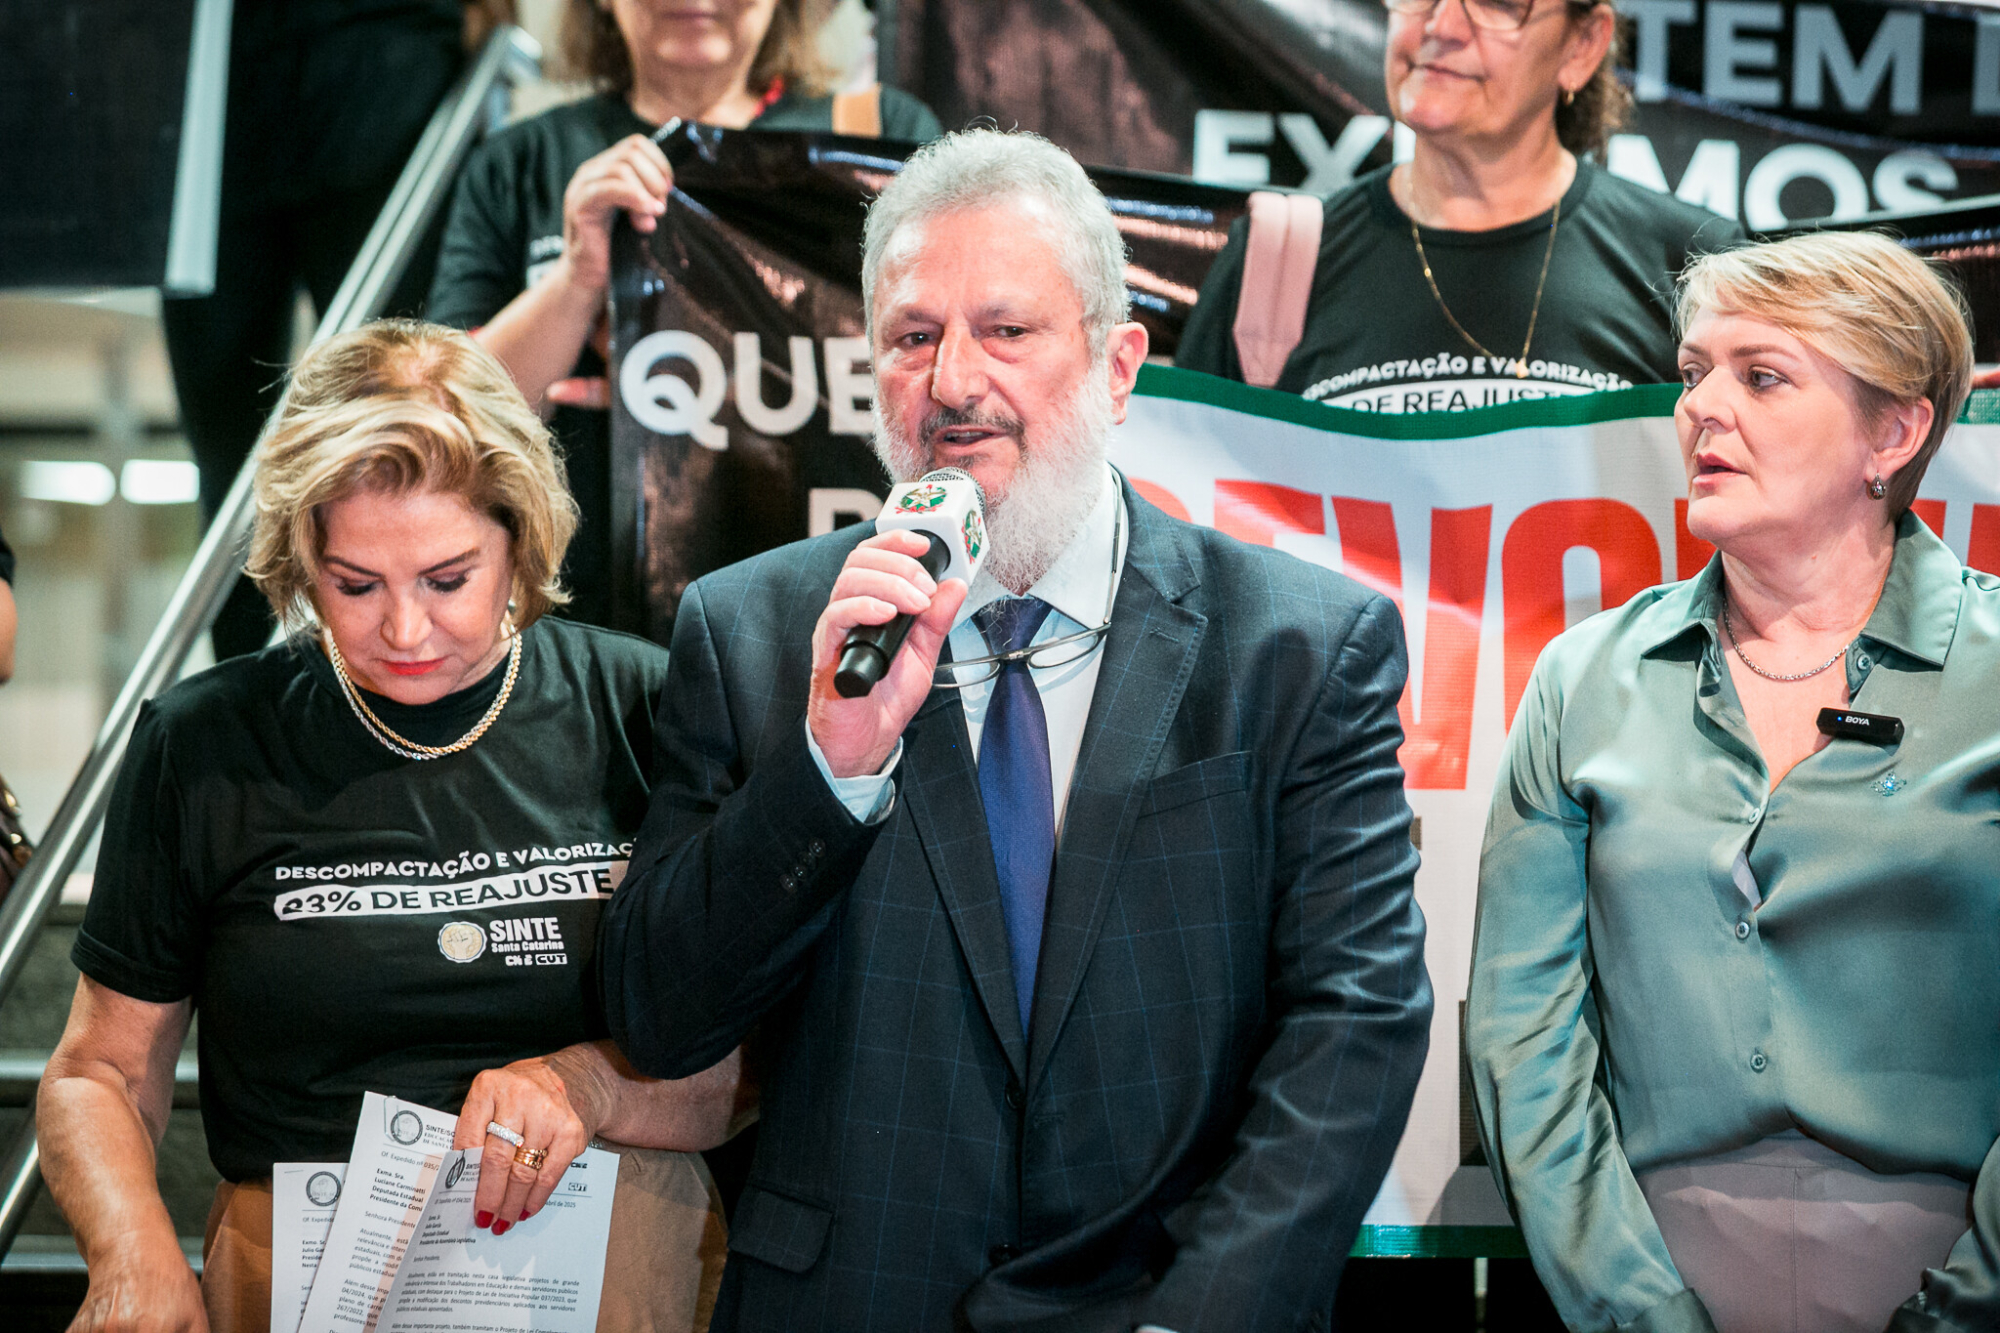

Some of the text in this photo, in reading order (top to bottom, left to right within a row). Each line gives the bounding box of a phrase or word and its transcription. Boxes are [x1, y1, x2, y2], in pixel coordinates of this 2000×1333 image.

[1472, 356, 1487, 375] E
[1845, 715, 1870, 726] BOYA
[275, 838, 637, 880] DESCOMPACTAÇÃO E VALORIZAÇ
[282, 868, 615, 915] 23% DE REAJUSTE
[489, 917, 562, 942] SINTE
[491, 940, 564, 953] Santa Catarina
[536, 954, 567, 966] CUT
[390, 1153, 415, 1165] Expedido
[394, 1172, 405, 1180] Sra.
[374, 1176, 426, 1195] Luciane Carminatti
[568, 1182, 587, 1191] CUT
[369, 1193, 399, 1206] Presidente
[372, 1185, 399, 1198] Deputada
[399, 1193, 424, 1203] Estadual
[364, 1210, 387, 1221] Senhora
[357, 1236, 385, 1248] relevância
[348, 1262, 372, 1273] públicos
[344, 1278, 359, 1287] Além
[359, 1283, 376, 1291] desse
[447, 1279, 477, 1288] Trabalhadores
[485, 1281, 508, 1290] Educação
[528, 1276, 549, 1284] projetos
[338, 1296, 356, 1305] plano
[356, 1299, 365, 1307] de
[367, 1294, 379, 1302] que
[498, 1291, 520, 1299] Iniciativa
[520, 1293, 540, 1301] Popular
[474, 1299, 510, 1308] previdenciários
[513, 1301, 536, 1309] aplicados
[550, 1304, 576, 1312] servidores
[333, 1313, 366, 1326] professores
[366, 1312, 379, 1320] que
[452, 1323, 472, 1331] também
[499, 1325, 518, 1333] Projeto
